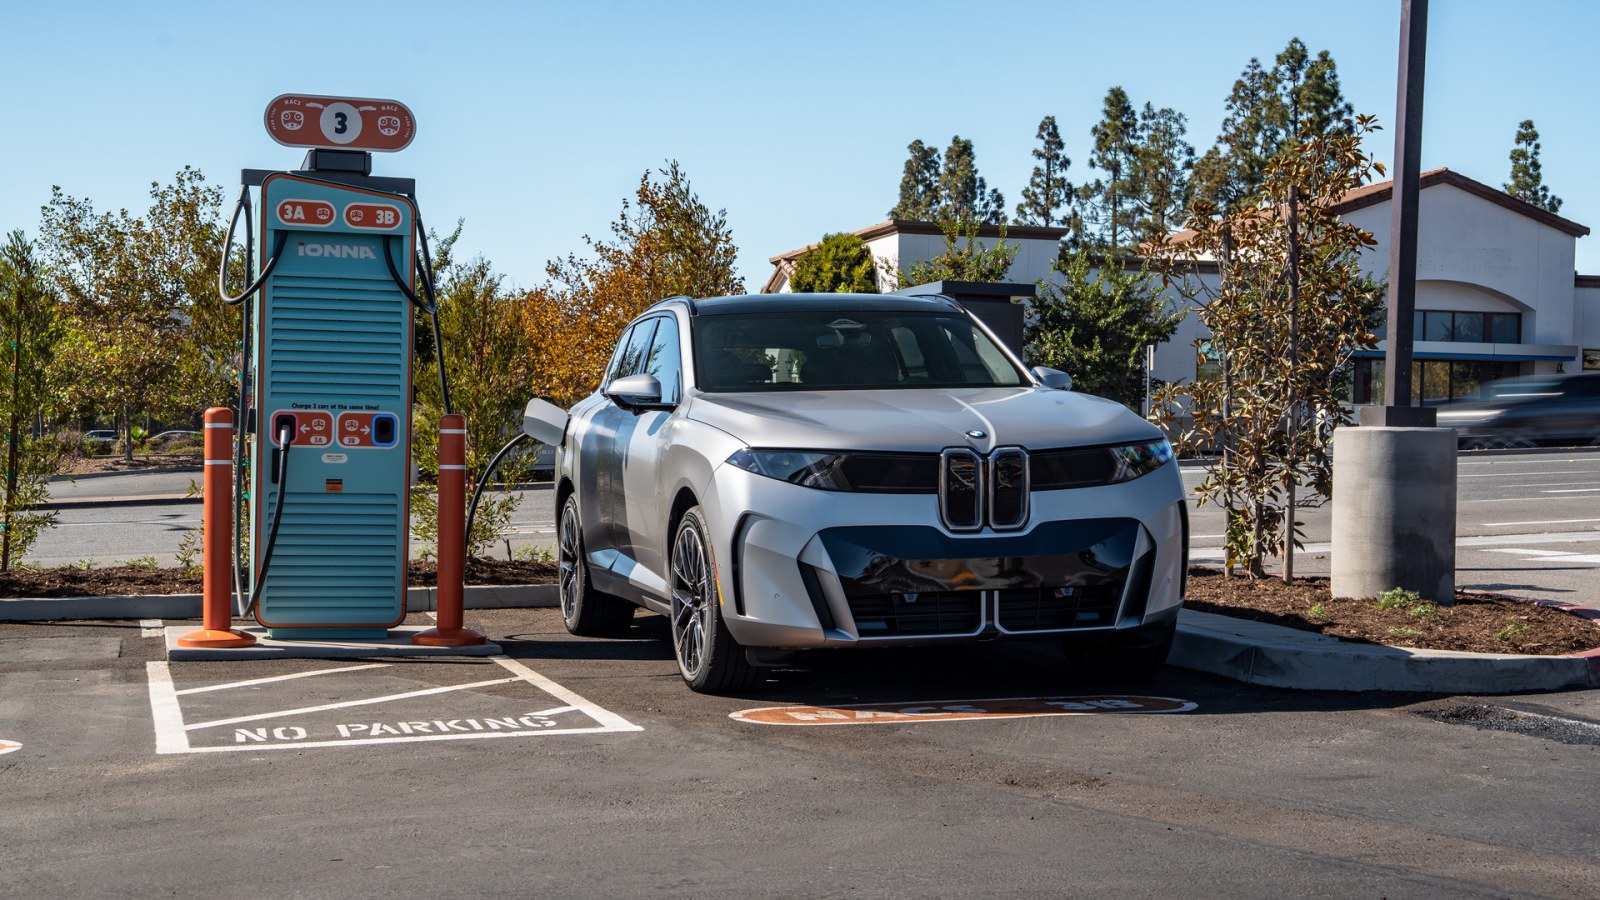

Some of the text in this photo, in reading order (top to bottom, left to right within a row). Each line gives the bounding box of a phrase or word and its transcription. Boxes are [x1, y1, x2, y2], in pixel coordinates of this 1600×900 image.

[334, 112, 347, 134] 3
[284, 204, 305, 220] 3A
[375, 209, 395, 224] 3B
[785, 699, 1144, 720] NACS 3B
[235, 716, 557, 742] NO PARKING
